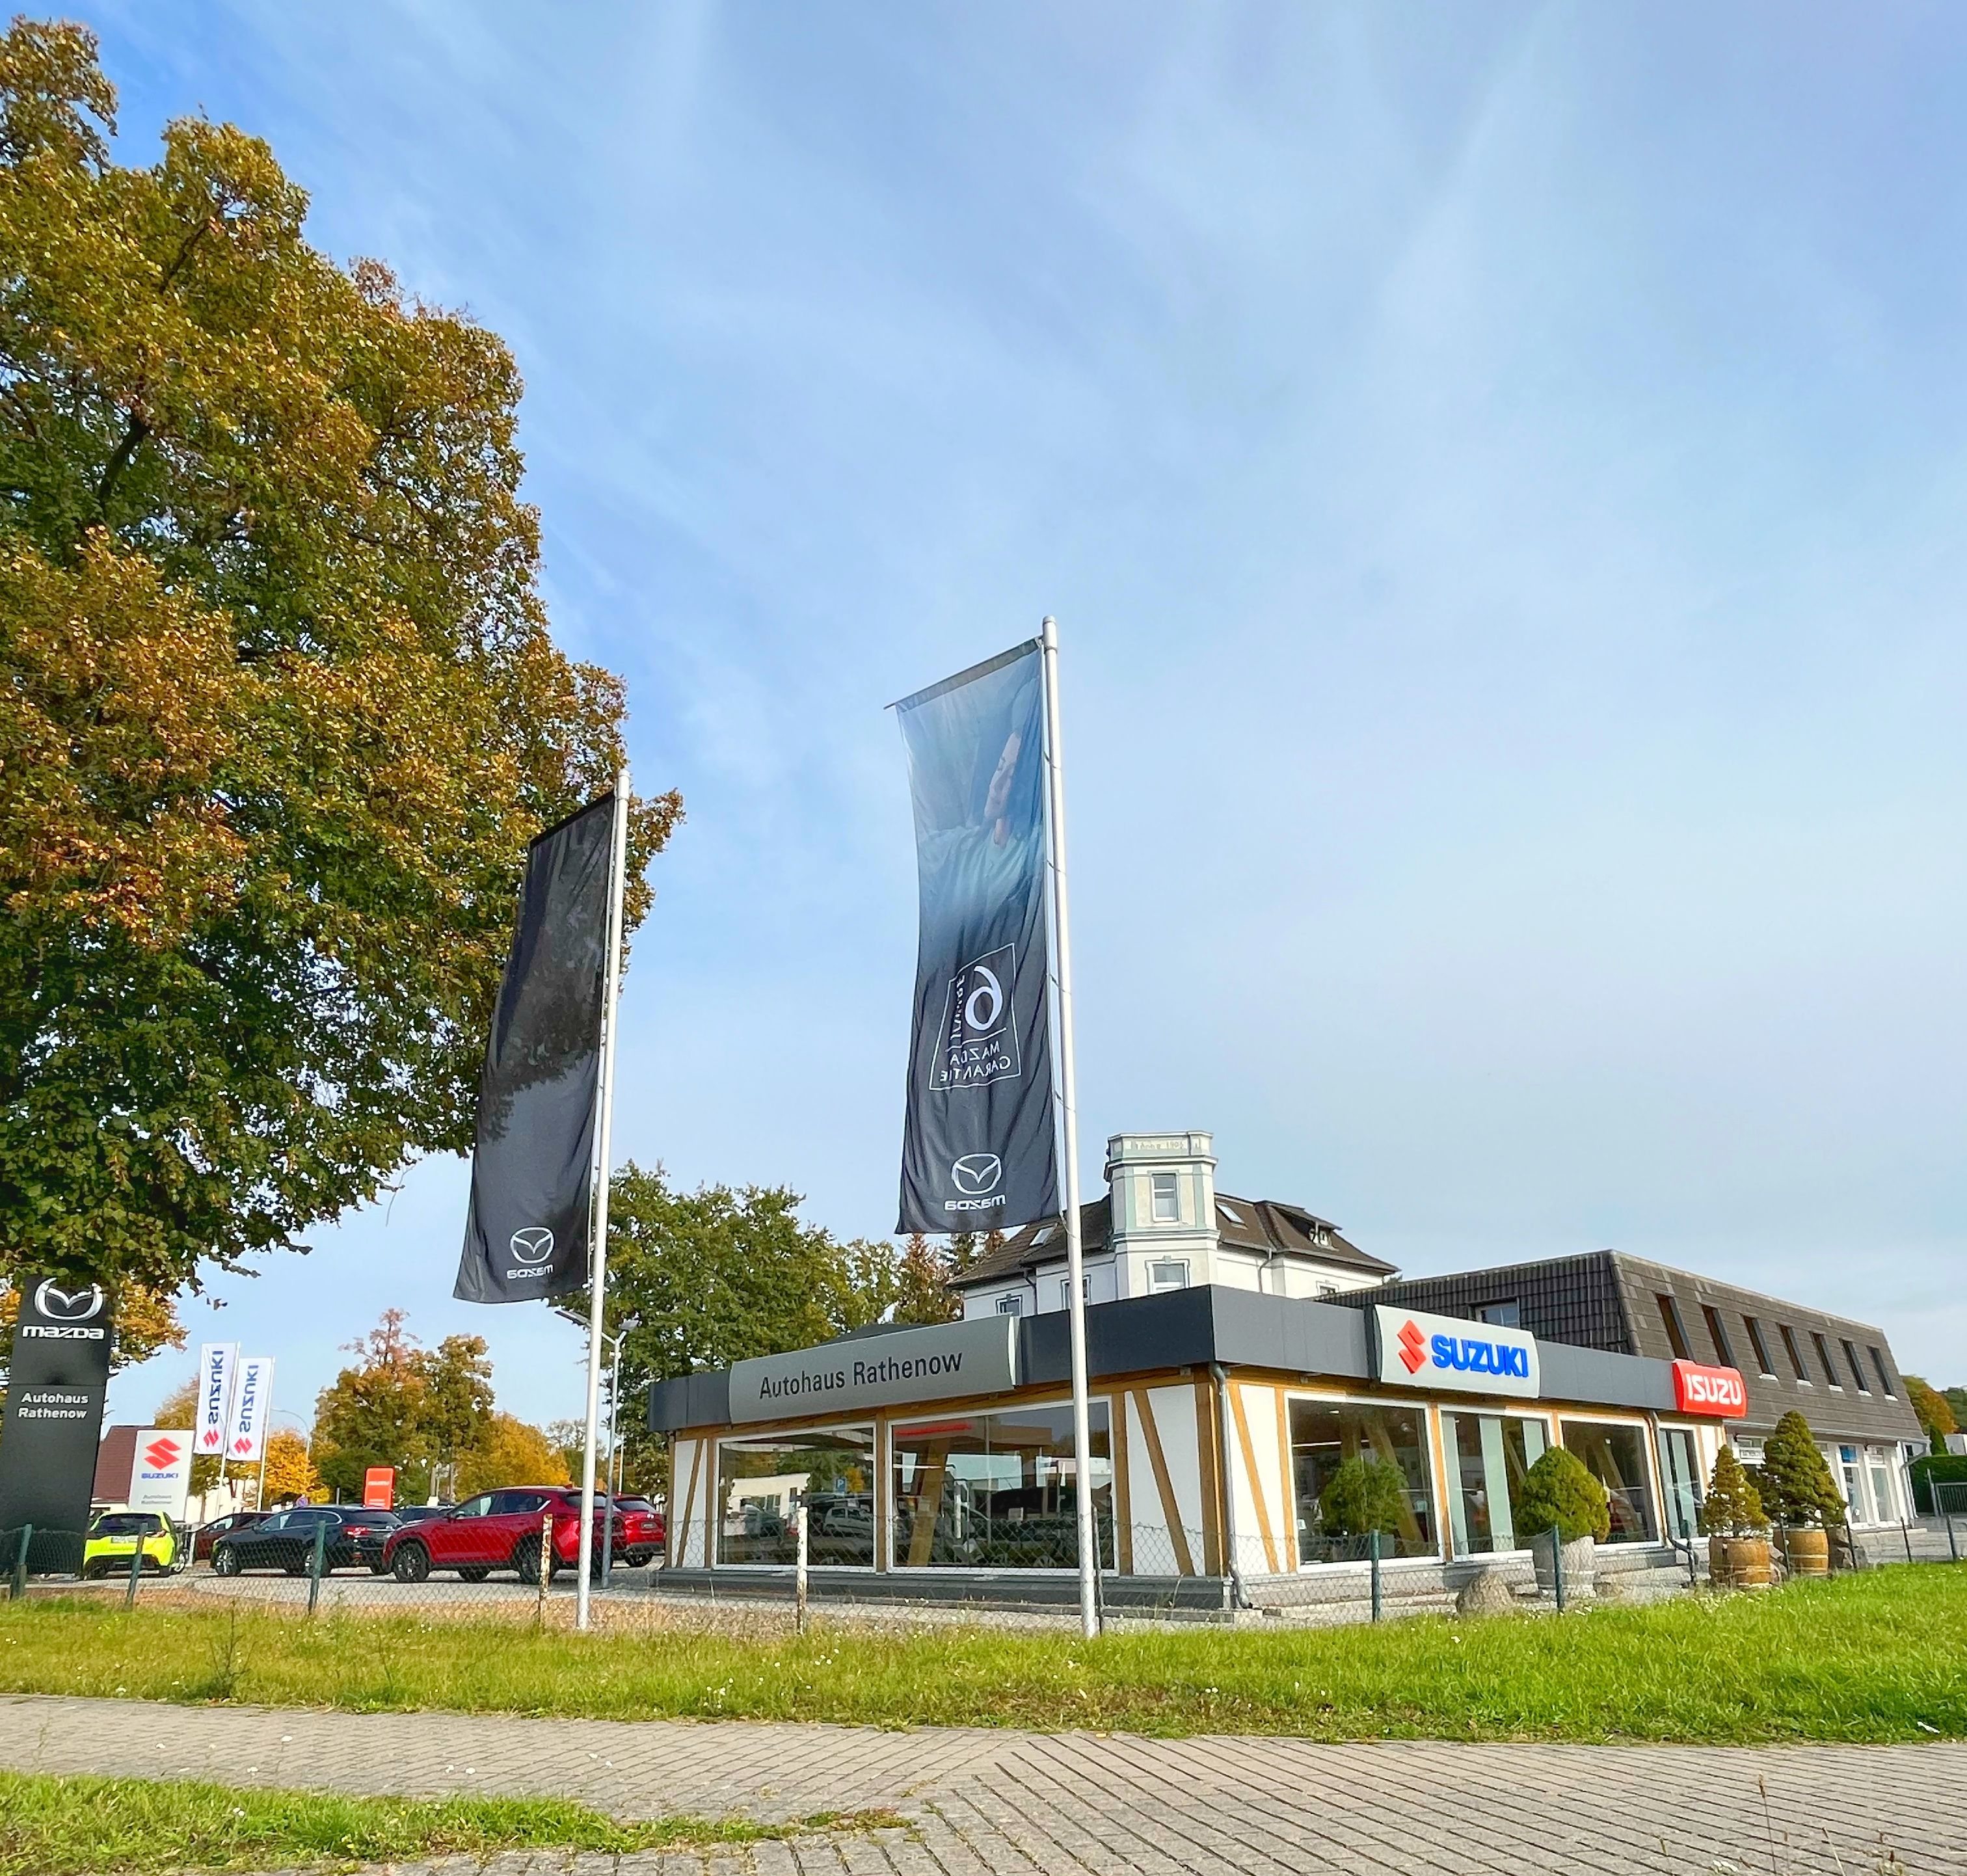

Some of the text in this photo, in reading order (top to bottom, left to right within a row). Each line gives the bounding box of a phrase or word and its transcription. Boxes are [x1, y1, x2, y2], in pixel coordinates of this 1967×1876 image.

[1430, 1333, 1529, 1379] SUZUKI
[758, 1352, 963, 1400] Autohaus Rathenow
[1685, 1373, 1743, 1406] ISUZU
[18, 1407, 88, 1419] Rathenow
[21, 1392, 88, 1404] Autohaus
